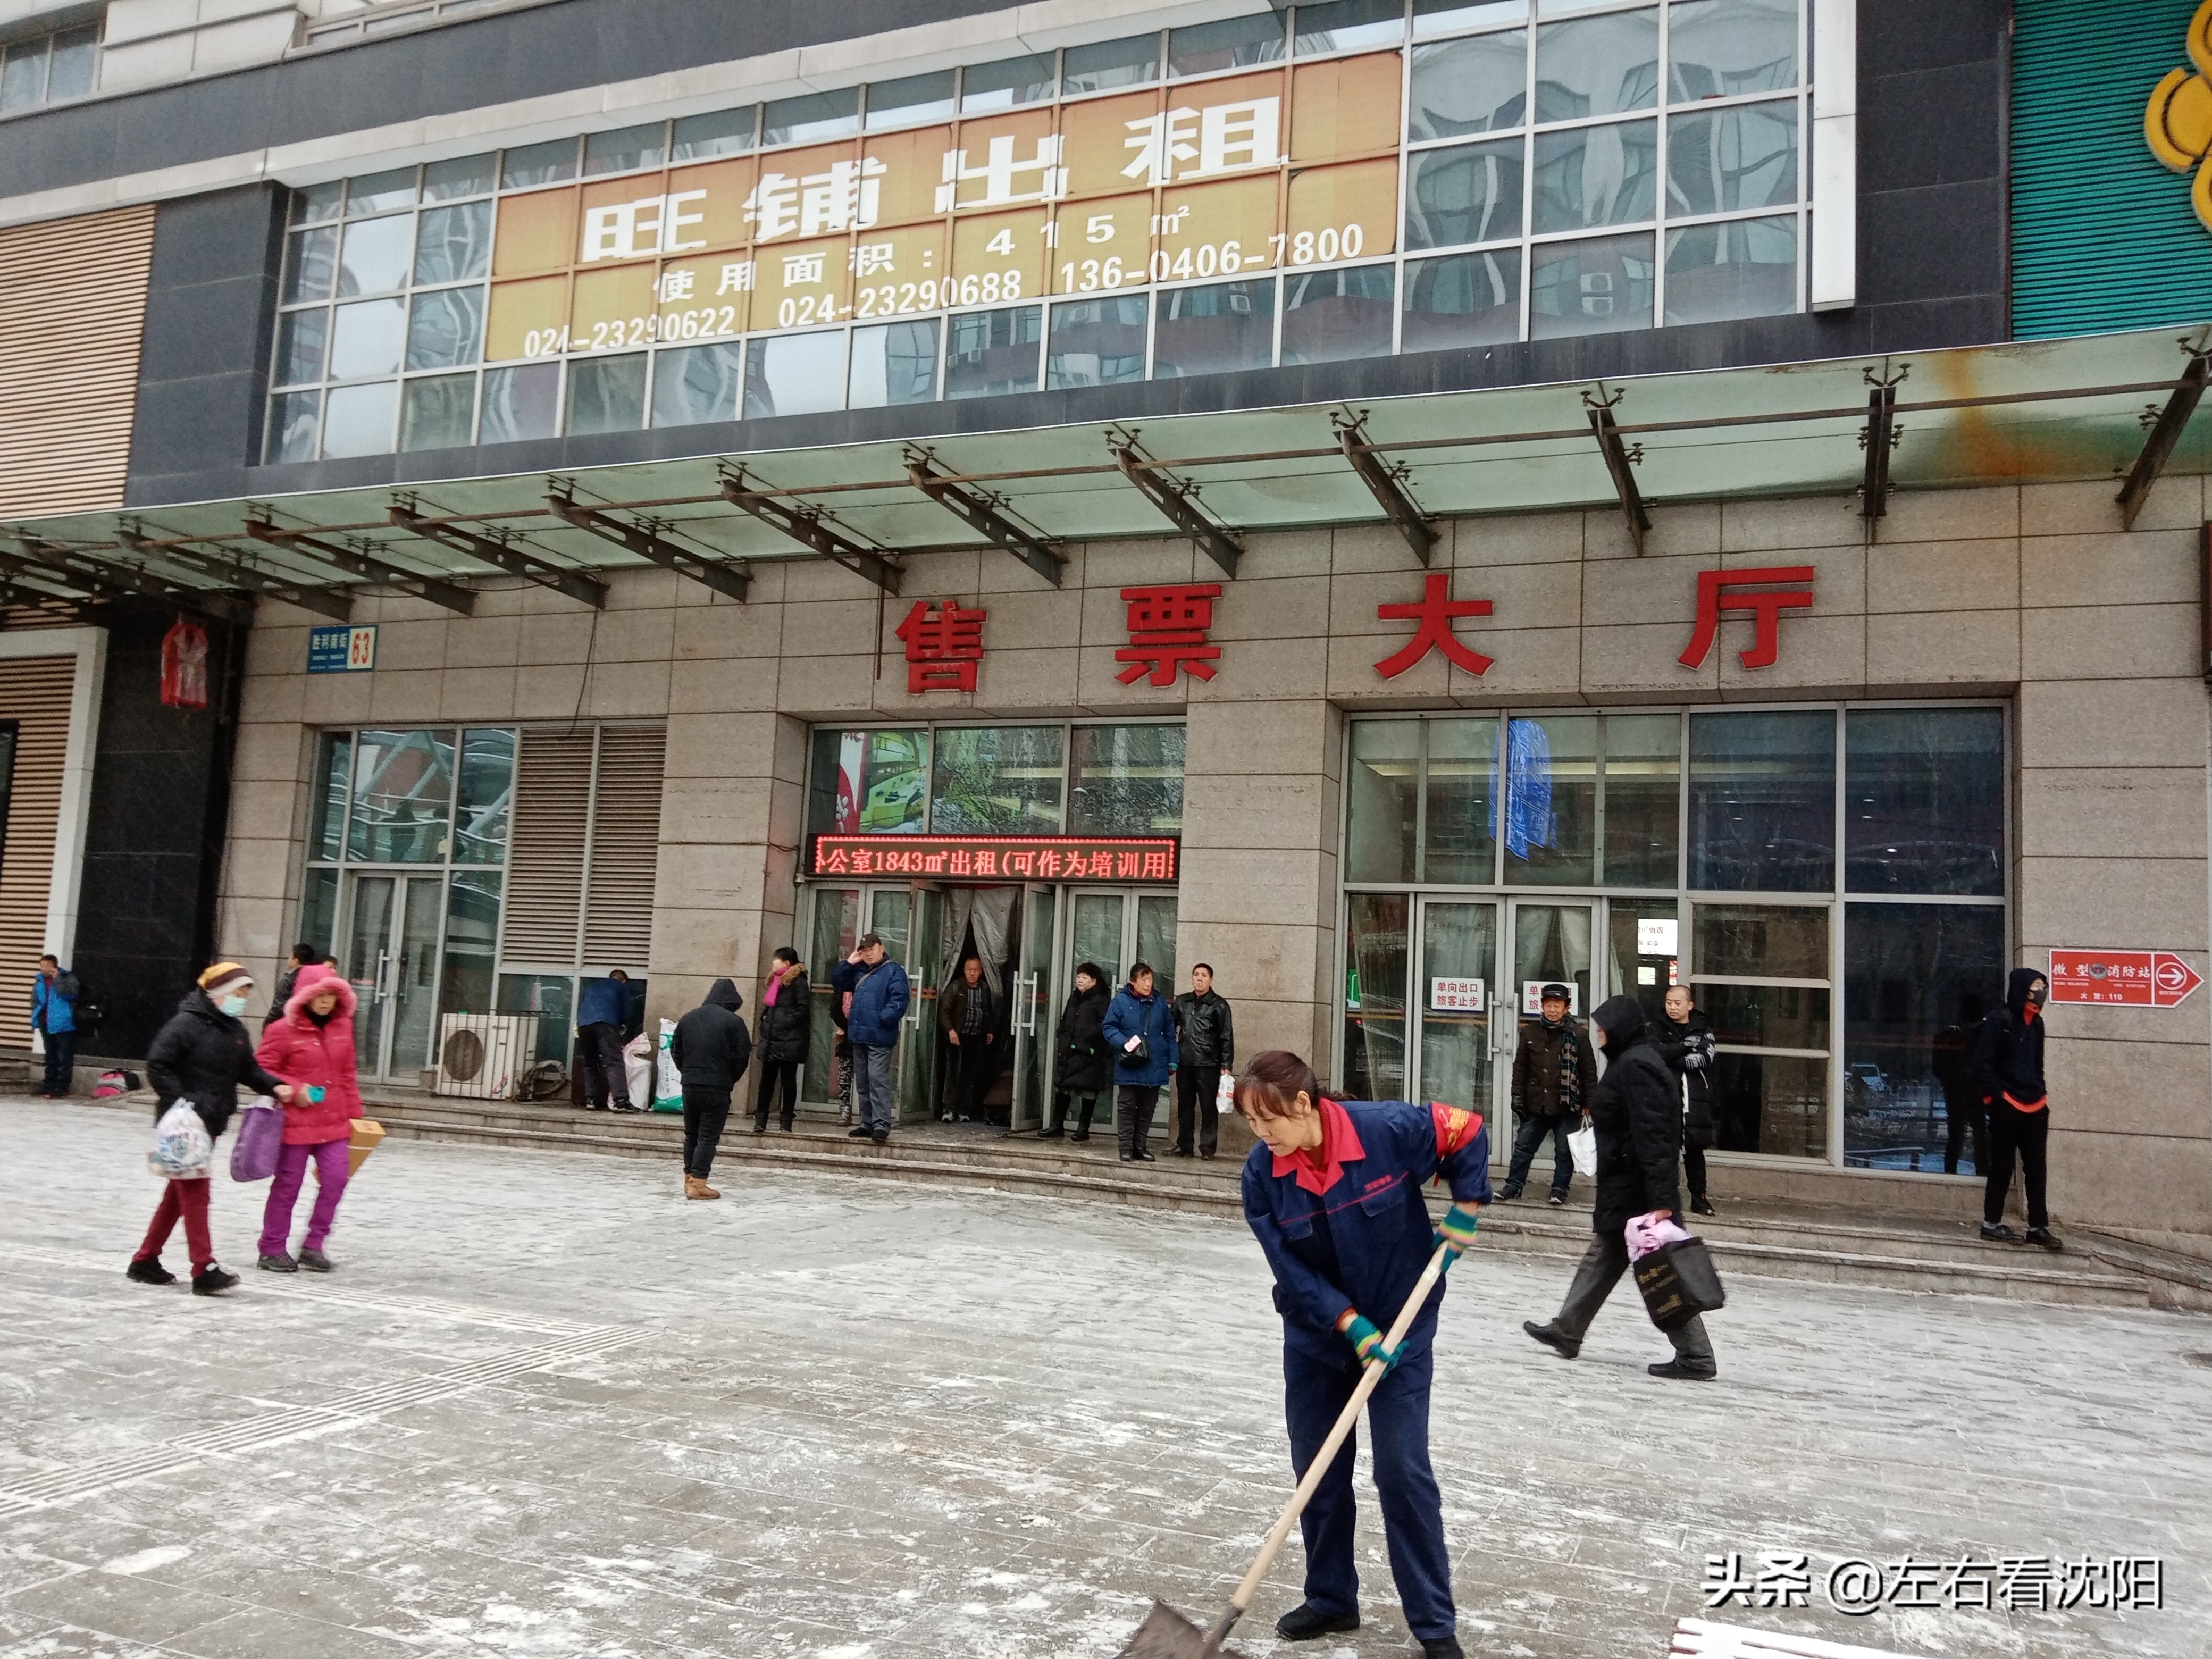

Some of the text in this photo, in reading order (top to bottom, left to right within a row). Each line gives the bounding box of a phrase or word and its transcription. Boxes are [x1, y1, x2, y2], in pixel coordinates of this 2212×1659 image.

[582, 96, 1289, 263] 旺铺出租
[524, 223, 1363, 358] 024-23290622 024-23290688 136-0406-7800
[894, 566, 1814, 696] 售票大厅
[352, 632, 370, 664] 63
[821, 848, 1167, 878] 公室1843㎡出租(可作为培训用
[1437, 981, 1478, 993] 单向出口
[1437, 995, 1479, 1007] 旅客止步
